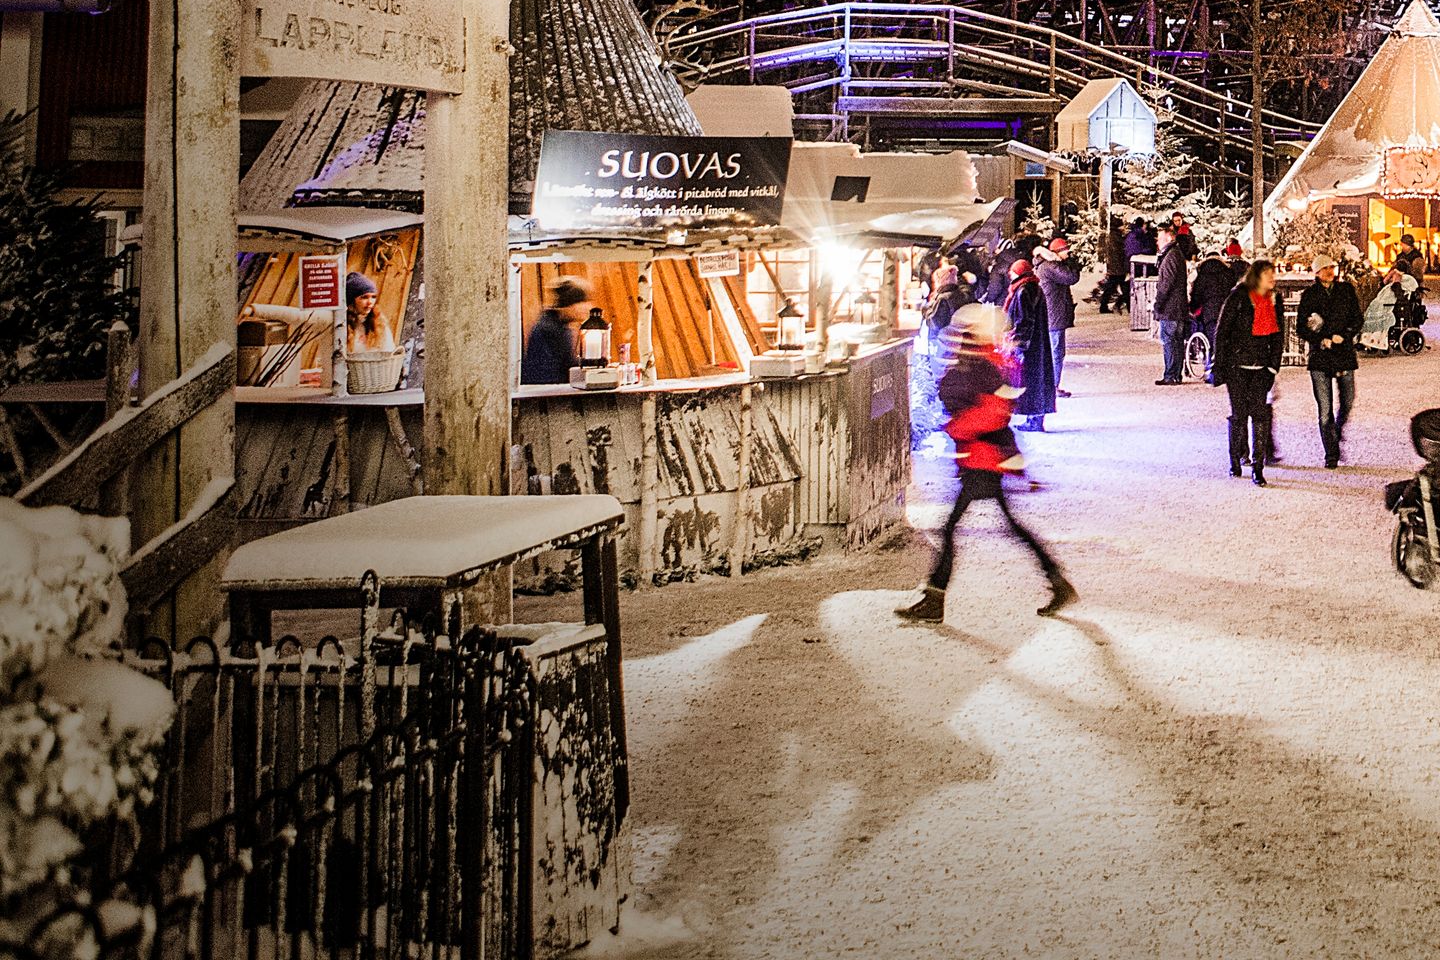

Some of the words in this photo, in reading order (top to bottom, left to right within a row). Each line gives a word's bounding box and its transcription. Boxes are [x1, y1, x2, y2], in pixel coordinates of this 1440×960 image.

[598, 149, 742, 180] SUOVAS
[677, 187, 683, 199] i
[684, 186, 727, 200] pitabröd
[728, 186, 750, 198] med
[750, 185, 779, 198] vitkål,
[641, 204, 663, 217] och
[664, 204, 703, 217] rårörda
